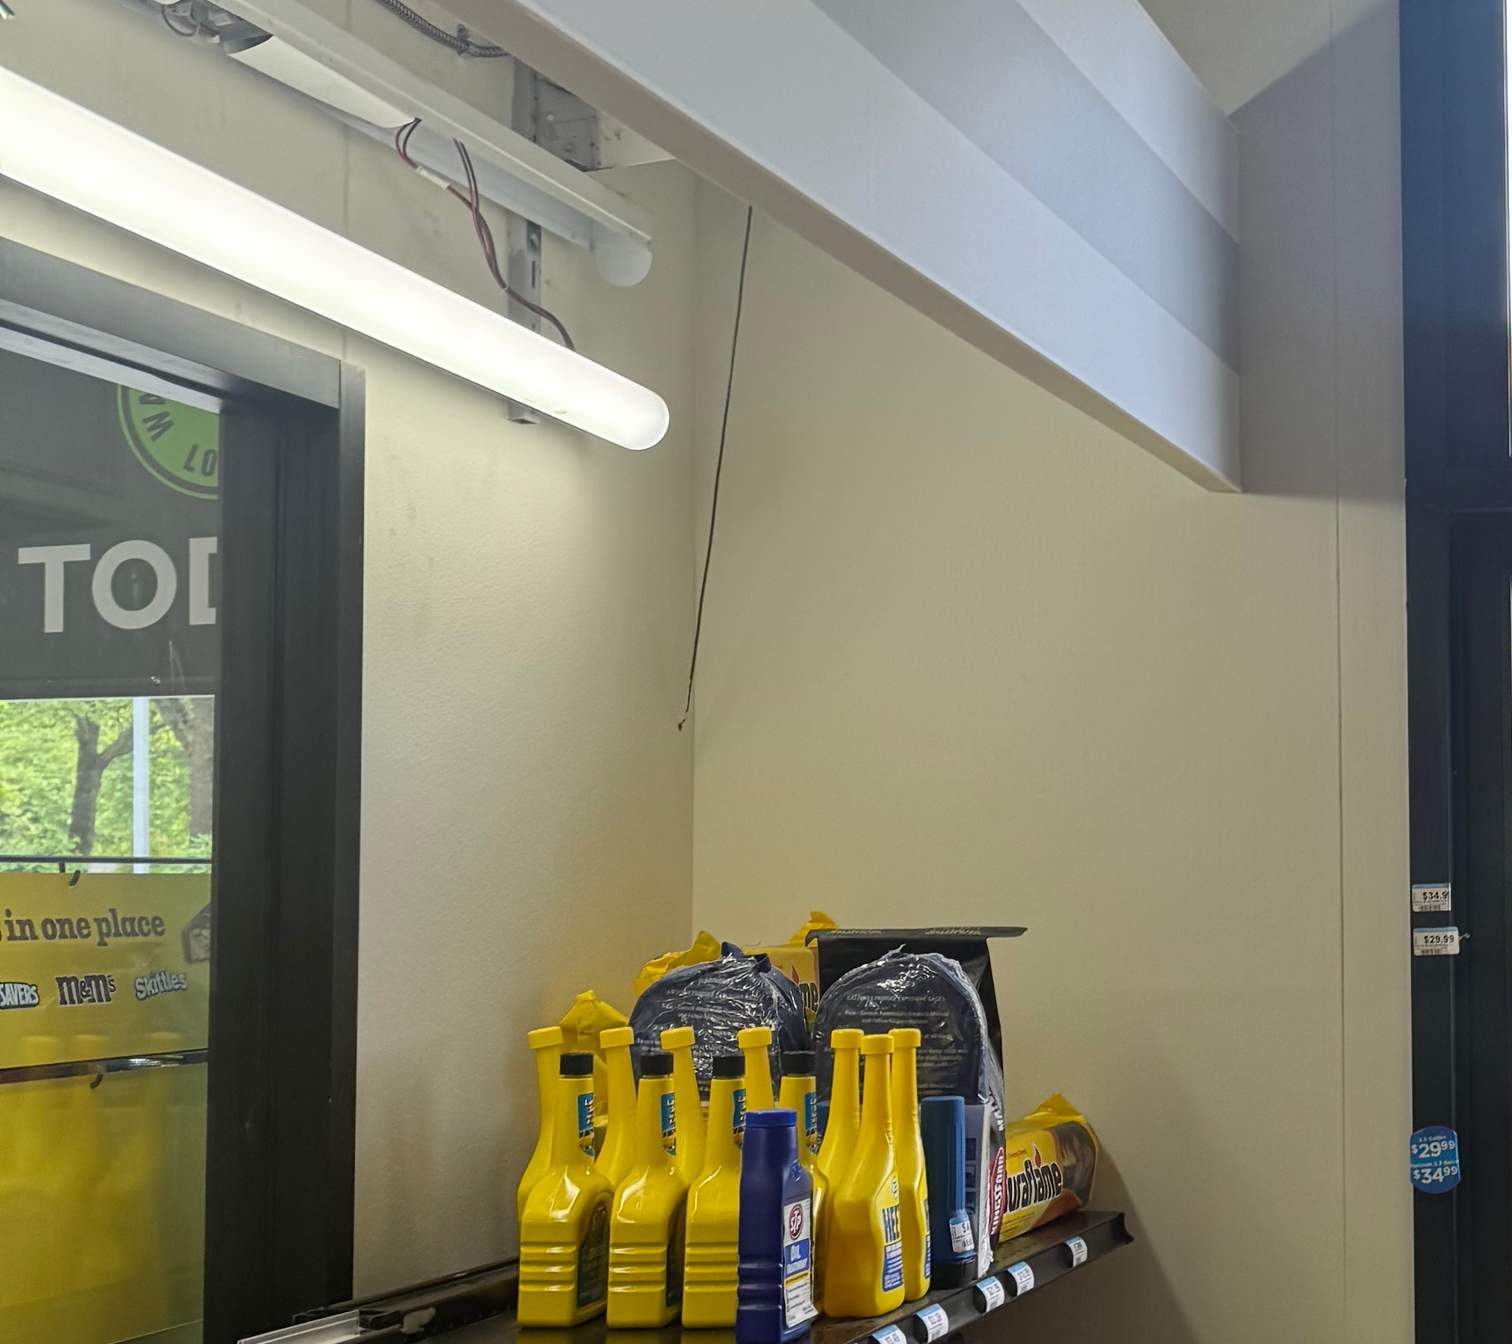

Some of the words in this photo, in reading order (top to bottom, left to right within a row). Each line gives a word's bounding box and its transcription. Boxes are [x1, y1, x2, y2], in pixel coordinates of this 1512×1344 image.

[5, 908, 38, 942] in
[40, 915, 91, 941] one
[93, 908, 166, 947] place
[1006, 1160, 1064, 1213] uraflame
